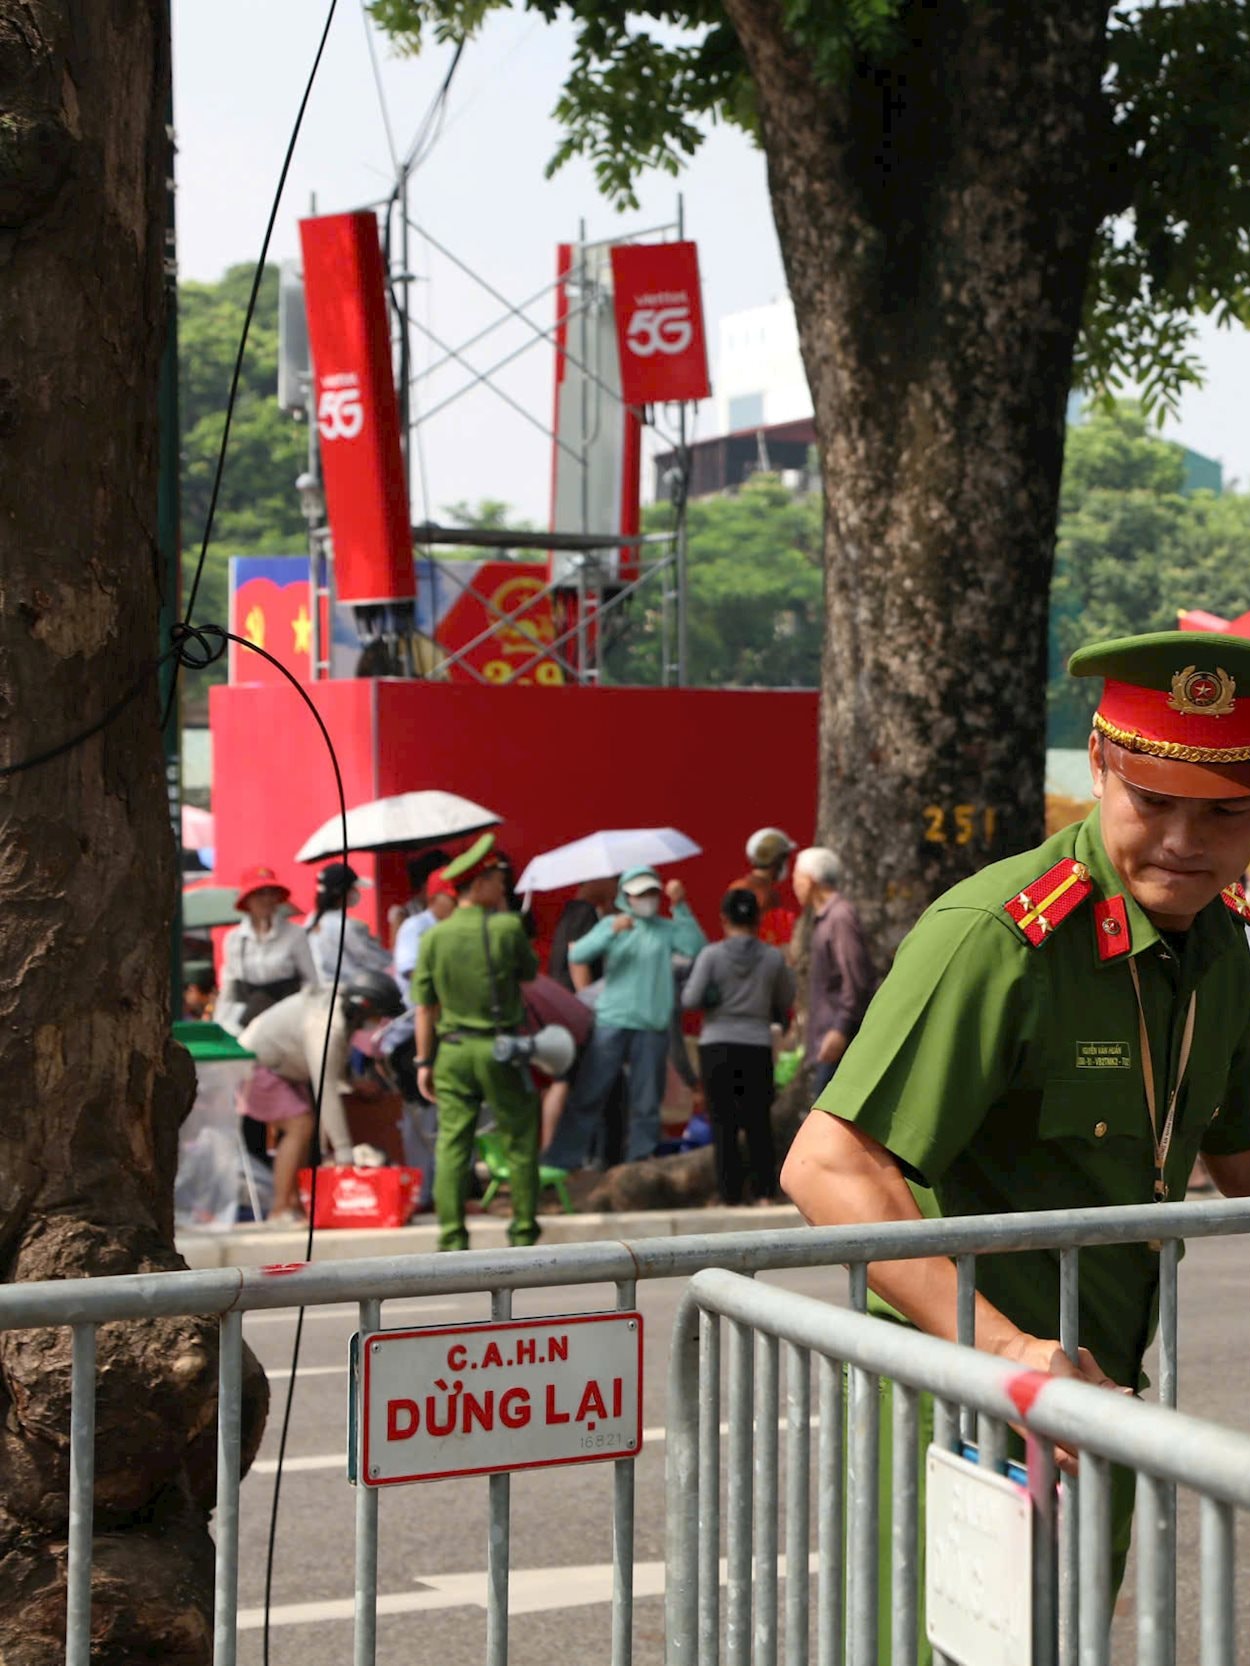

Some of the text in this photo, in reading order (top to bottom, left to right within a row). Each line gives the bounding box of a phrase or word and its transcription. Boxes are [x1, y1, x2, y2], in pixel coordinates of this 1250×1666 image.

[626, 307, 693, 357] 5G
[318, 389, 364, 440] 5G
[922, 803, 996, 846] 251
[447, 1335, 568, 1371] C.A.H.N
[387, 1377, 623, 1441] DỪNG LẠI
